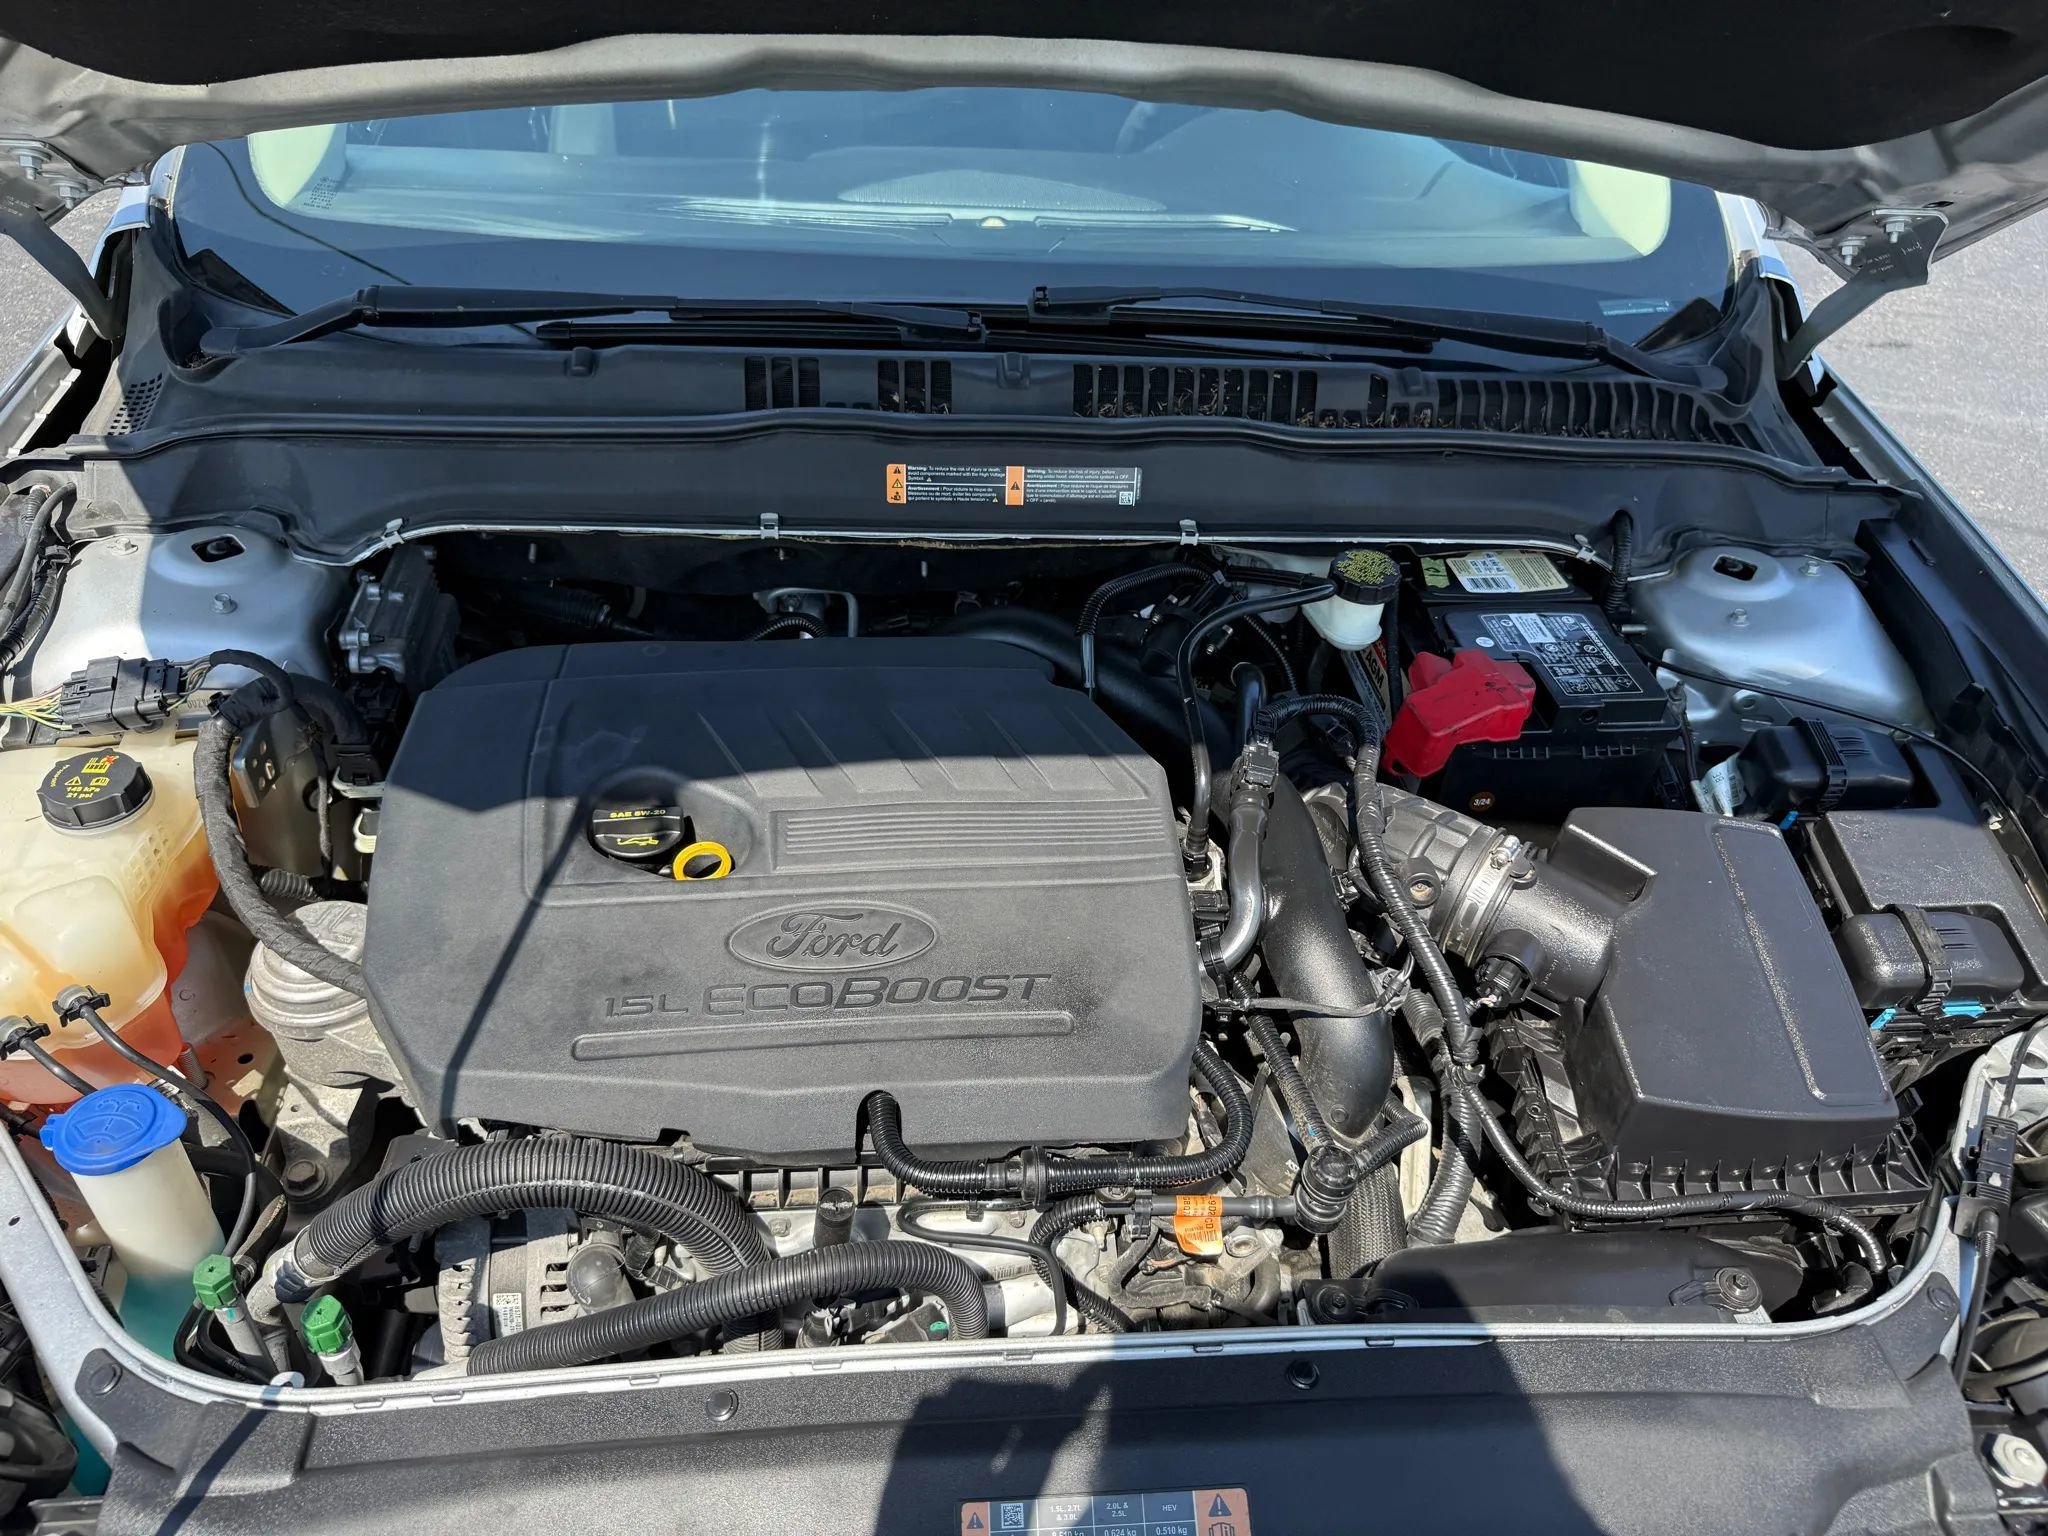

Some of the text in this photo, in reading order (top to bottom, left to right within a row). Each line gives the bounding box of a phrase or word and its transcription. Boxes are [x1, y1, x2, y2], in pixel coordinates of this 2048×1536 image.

[1364, 650, 1385, 689] AGM
[1474, 798, 1490, 806] 3/24
[766, 909, 901, 959] Ford
[606, 994, 688, 1018] 1.5L
[1156, 1526, 1188, 1536] 0.510 kg
